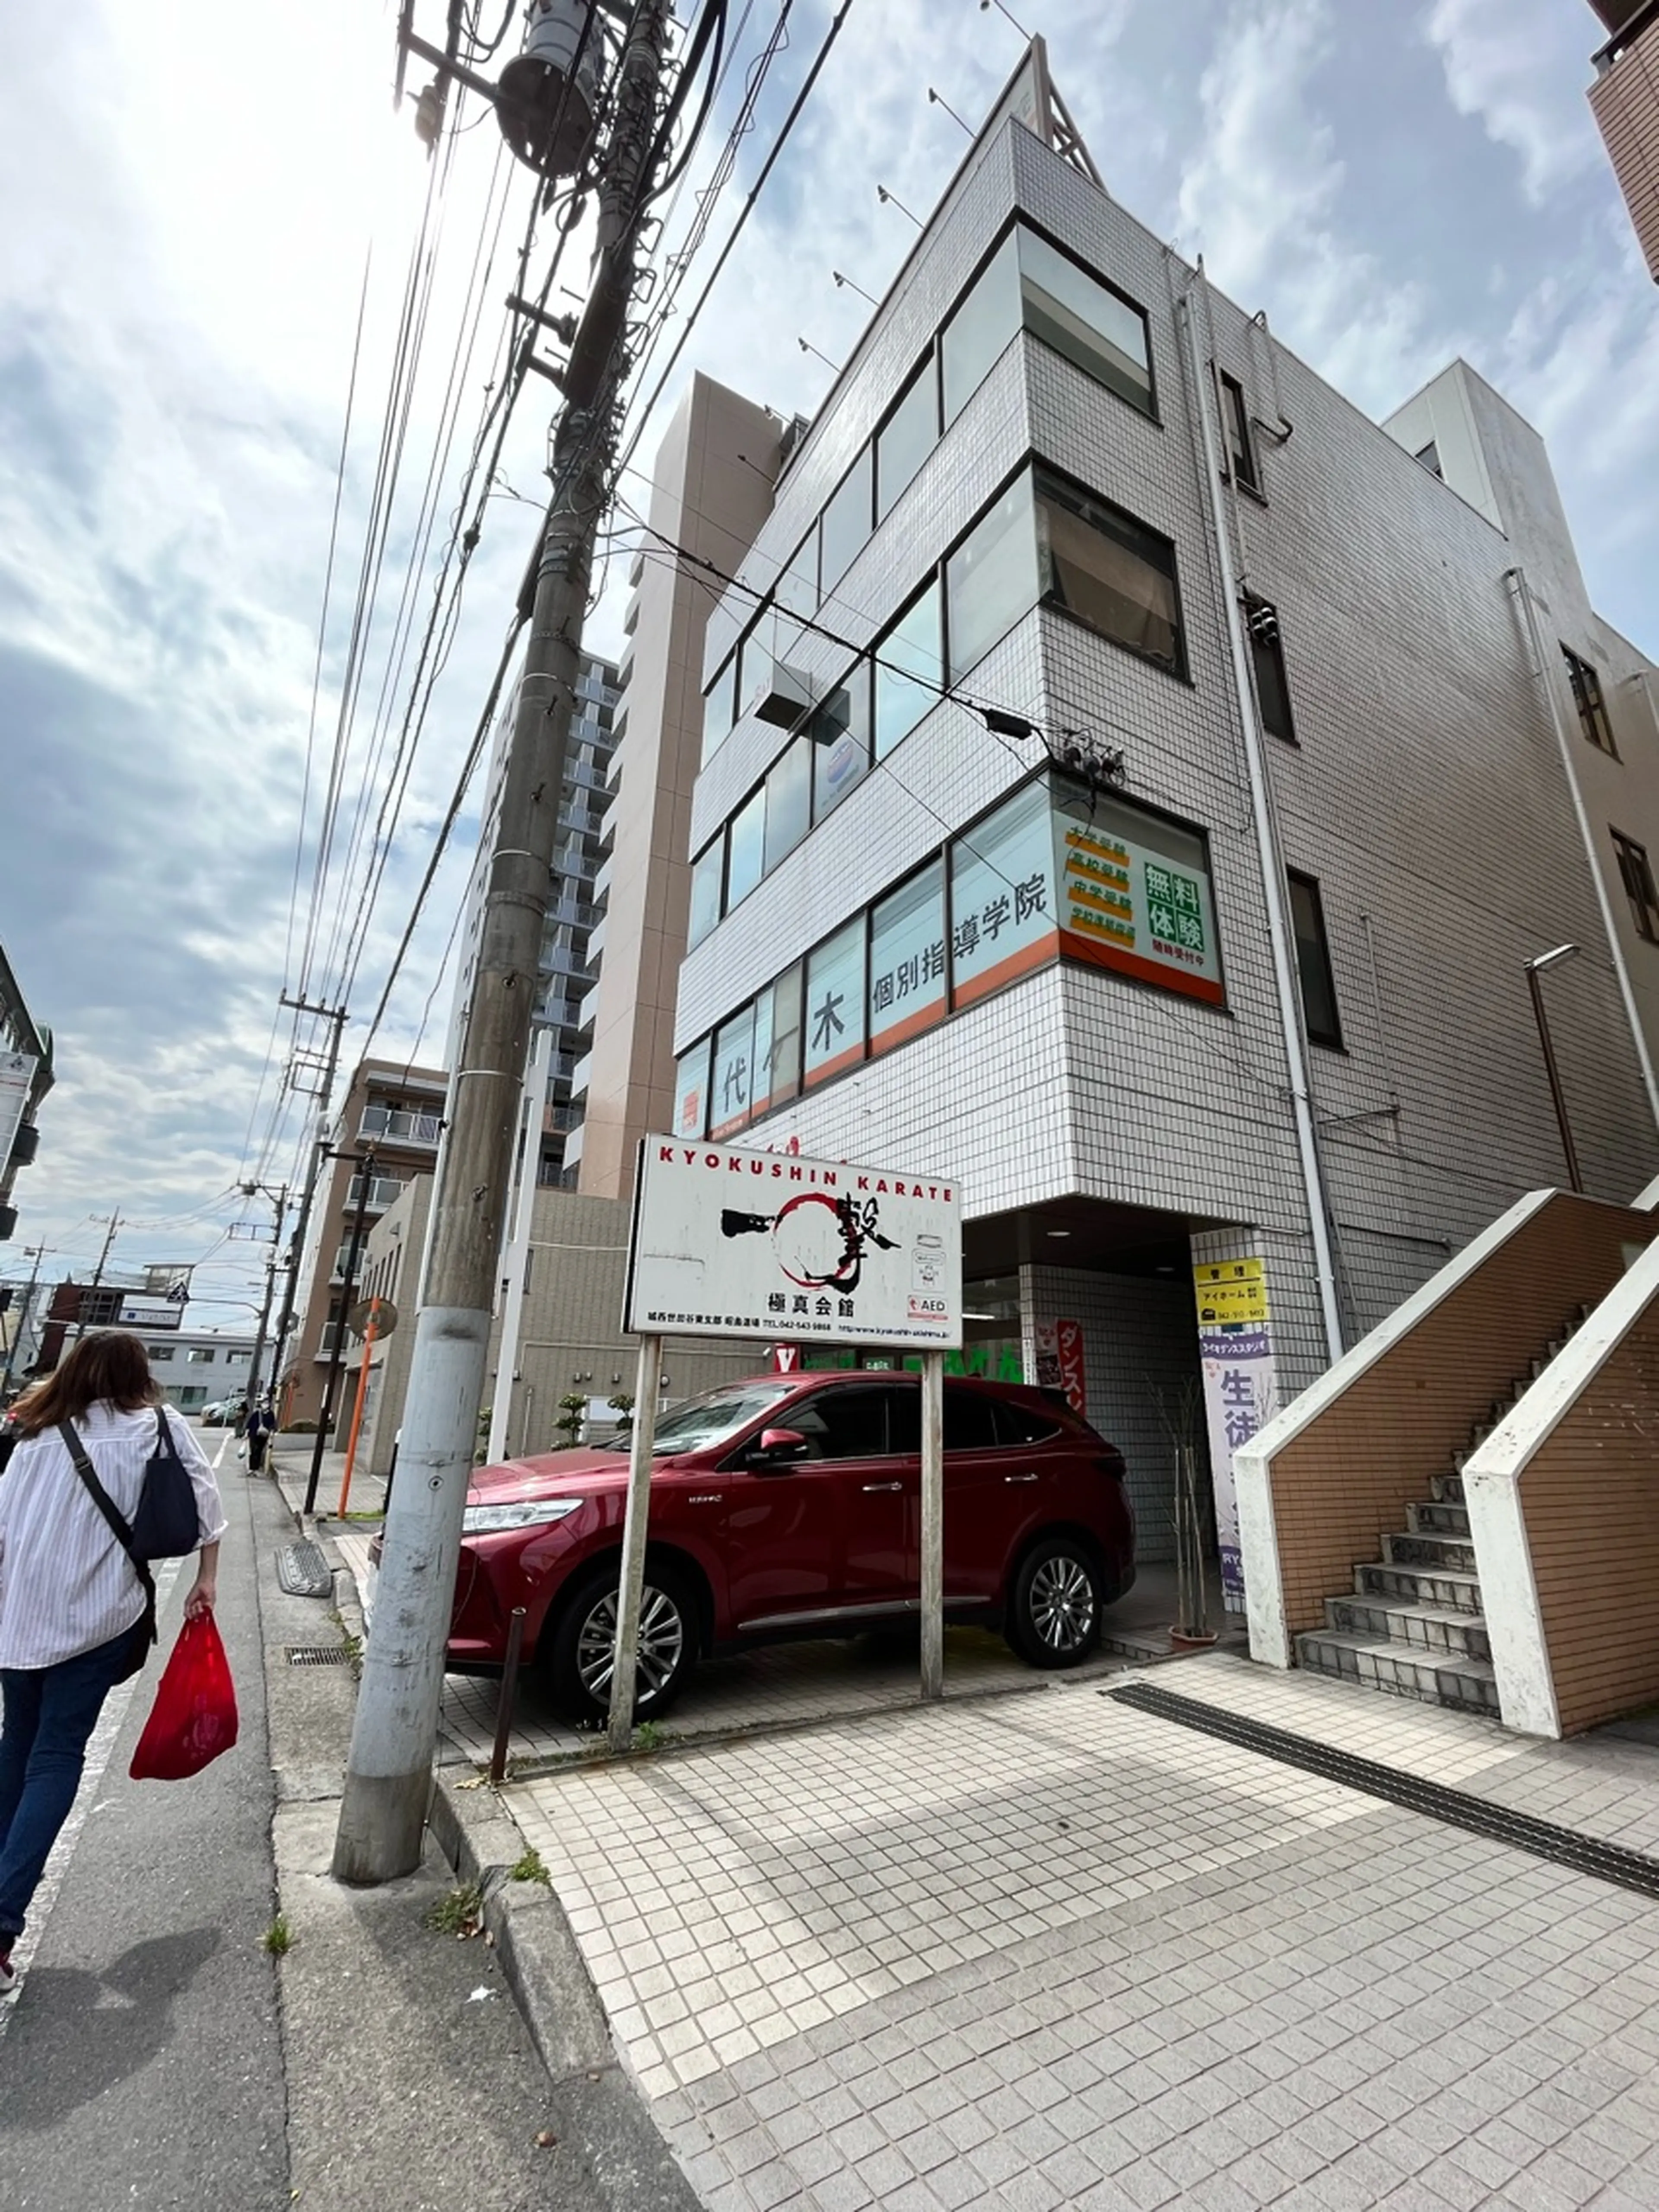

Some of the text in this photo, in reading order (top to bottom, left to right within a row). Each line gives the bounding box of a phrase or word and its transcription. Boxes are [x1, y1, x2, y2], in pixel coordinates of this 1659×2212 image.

[1146, 865, 1198, 912] 無料
[872, 873, 1048, 1014] 個別指導学院
[1150, 904, 1203, 950] 体験
[660, 1146, 952, 1202] KYOKUSHIN KARATE
[768, 1292, 854, 1317] 極真会館
[921, 1300, 945, 1311] AED
